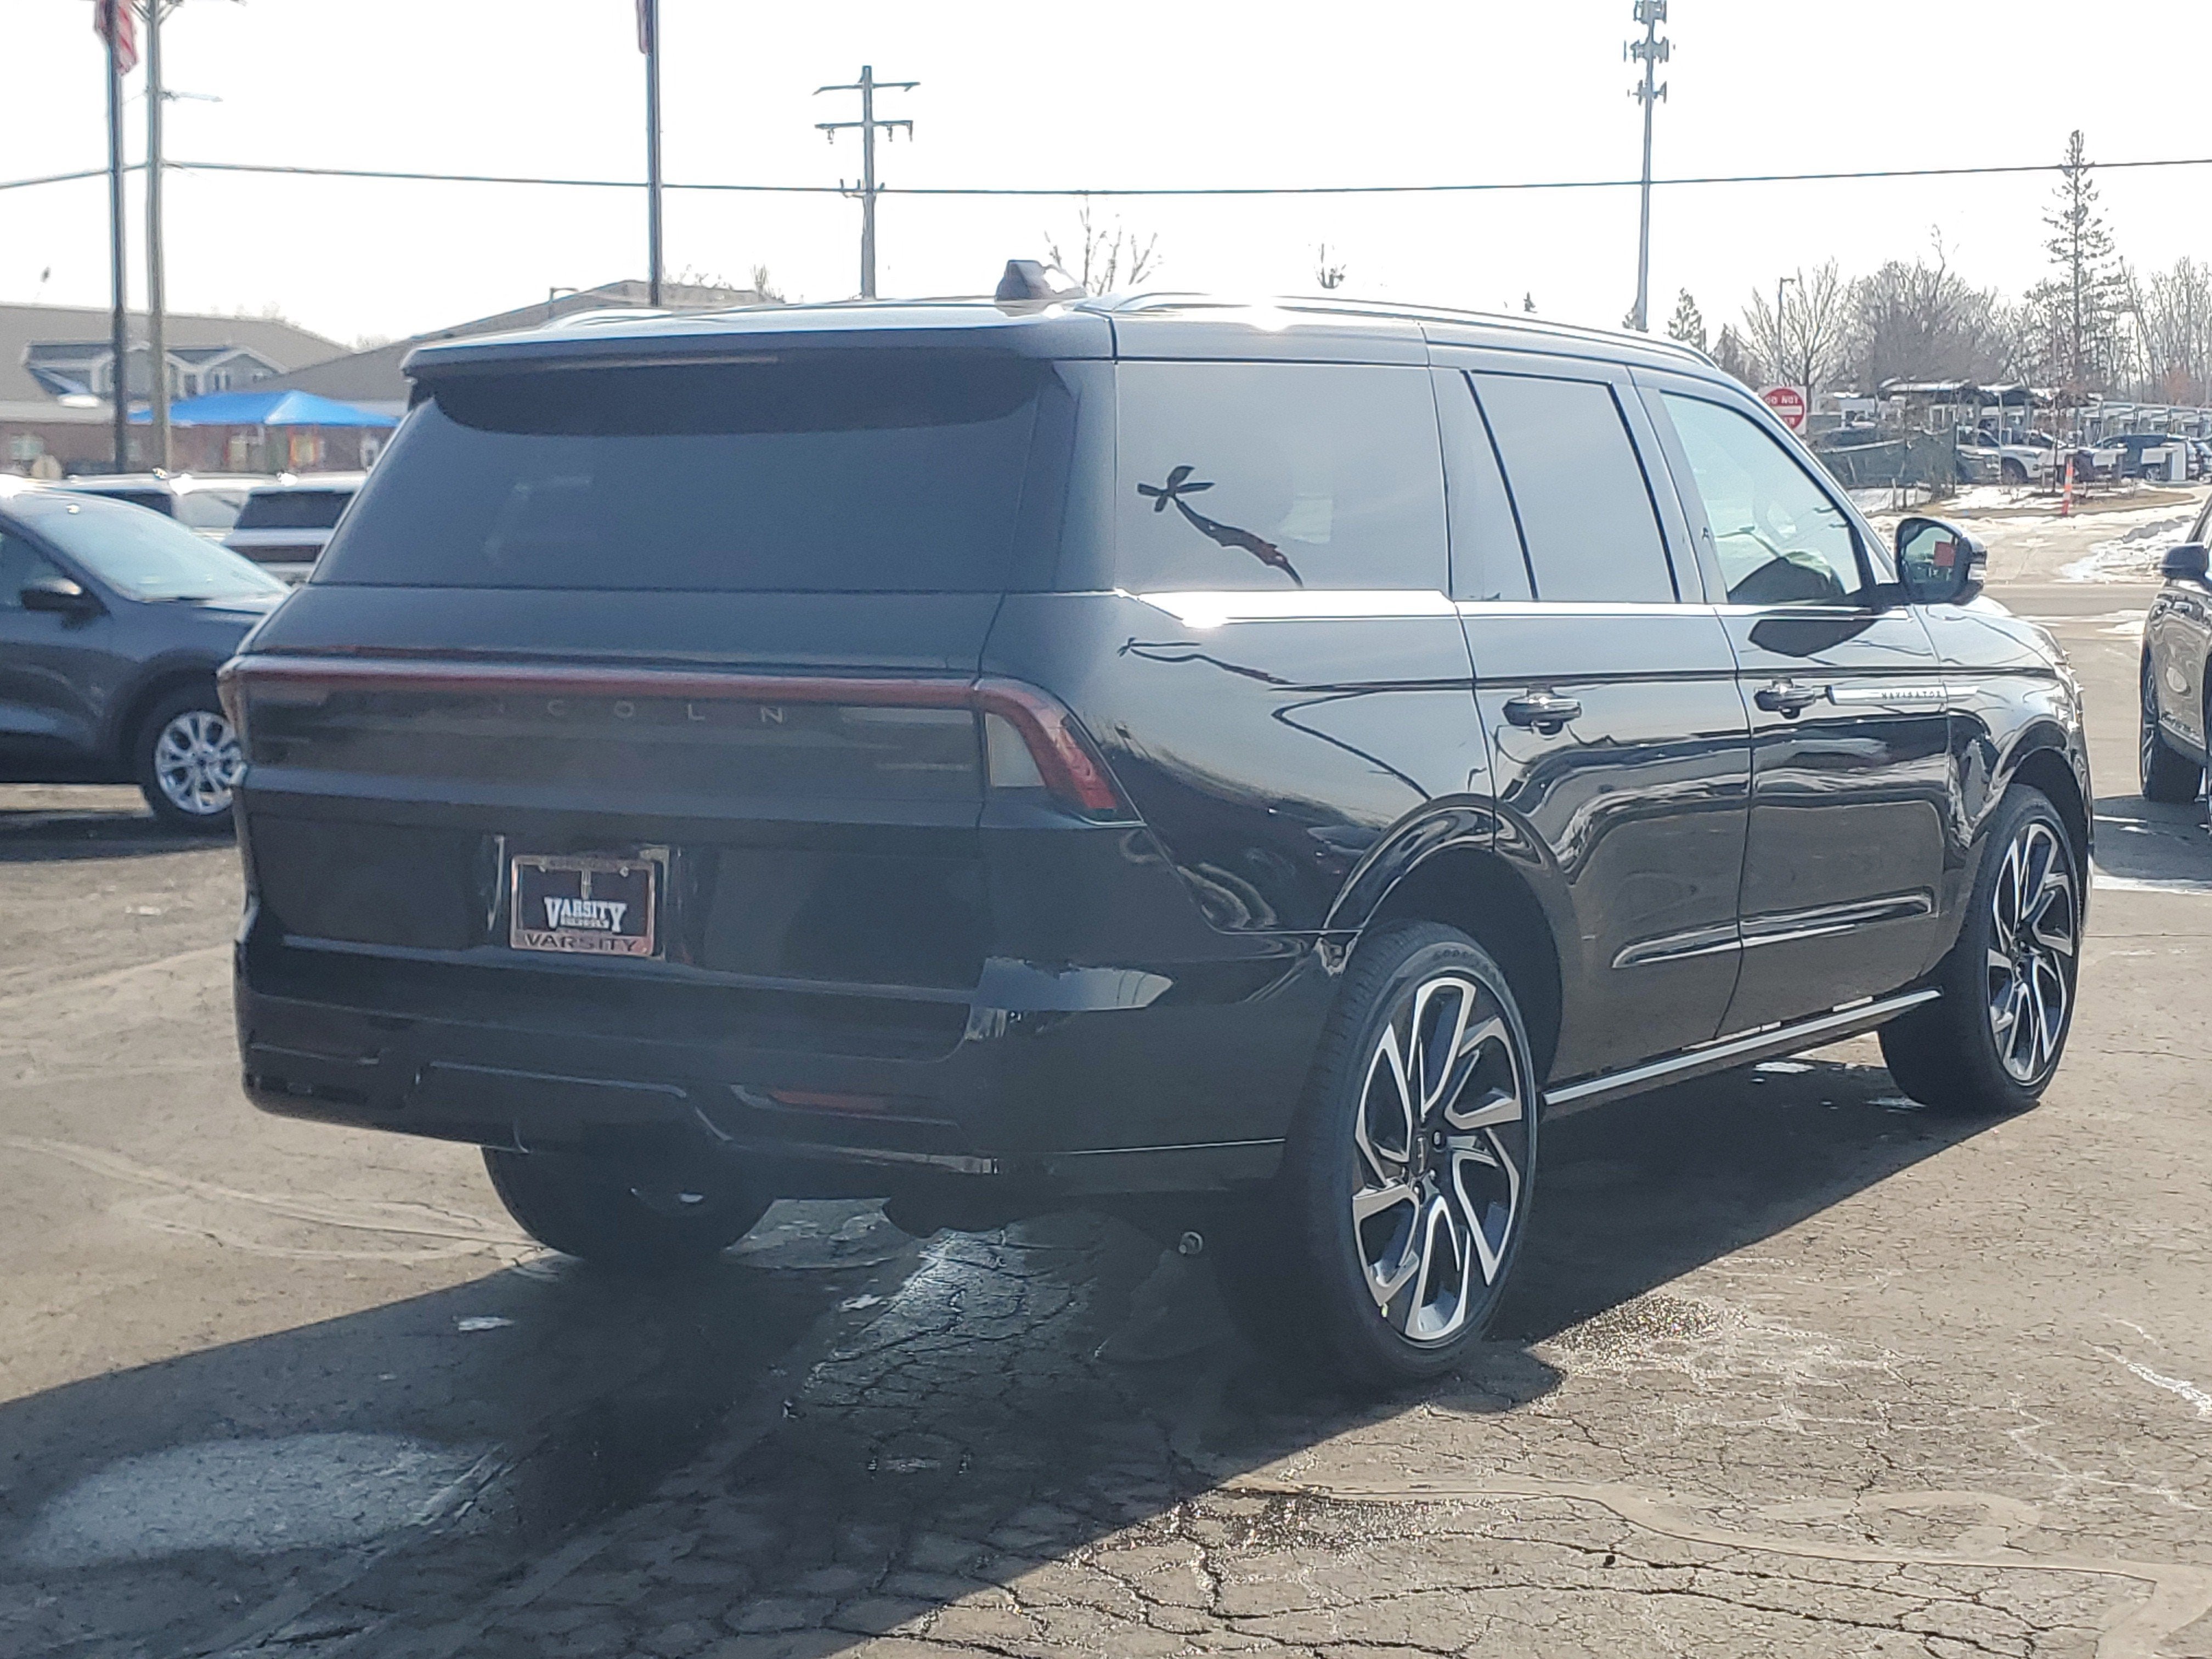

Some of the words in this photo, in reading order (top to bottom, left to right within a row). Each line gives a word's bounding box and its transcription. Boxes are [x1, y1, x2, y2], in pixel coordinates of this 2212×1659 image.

[1764, 395, 1778, 404] DO
[1781, 394, 1799, 404] NOT
[544, 896, 628, 933] VARSITY
[524, 933, 637, 952] VARSITY
